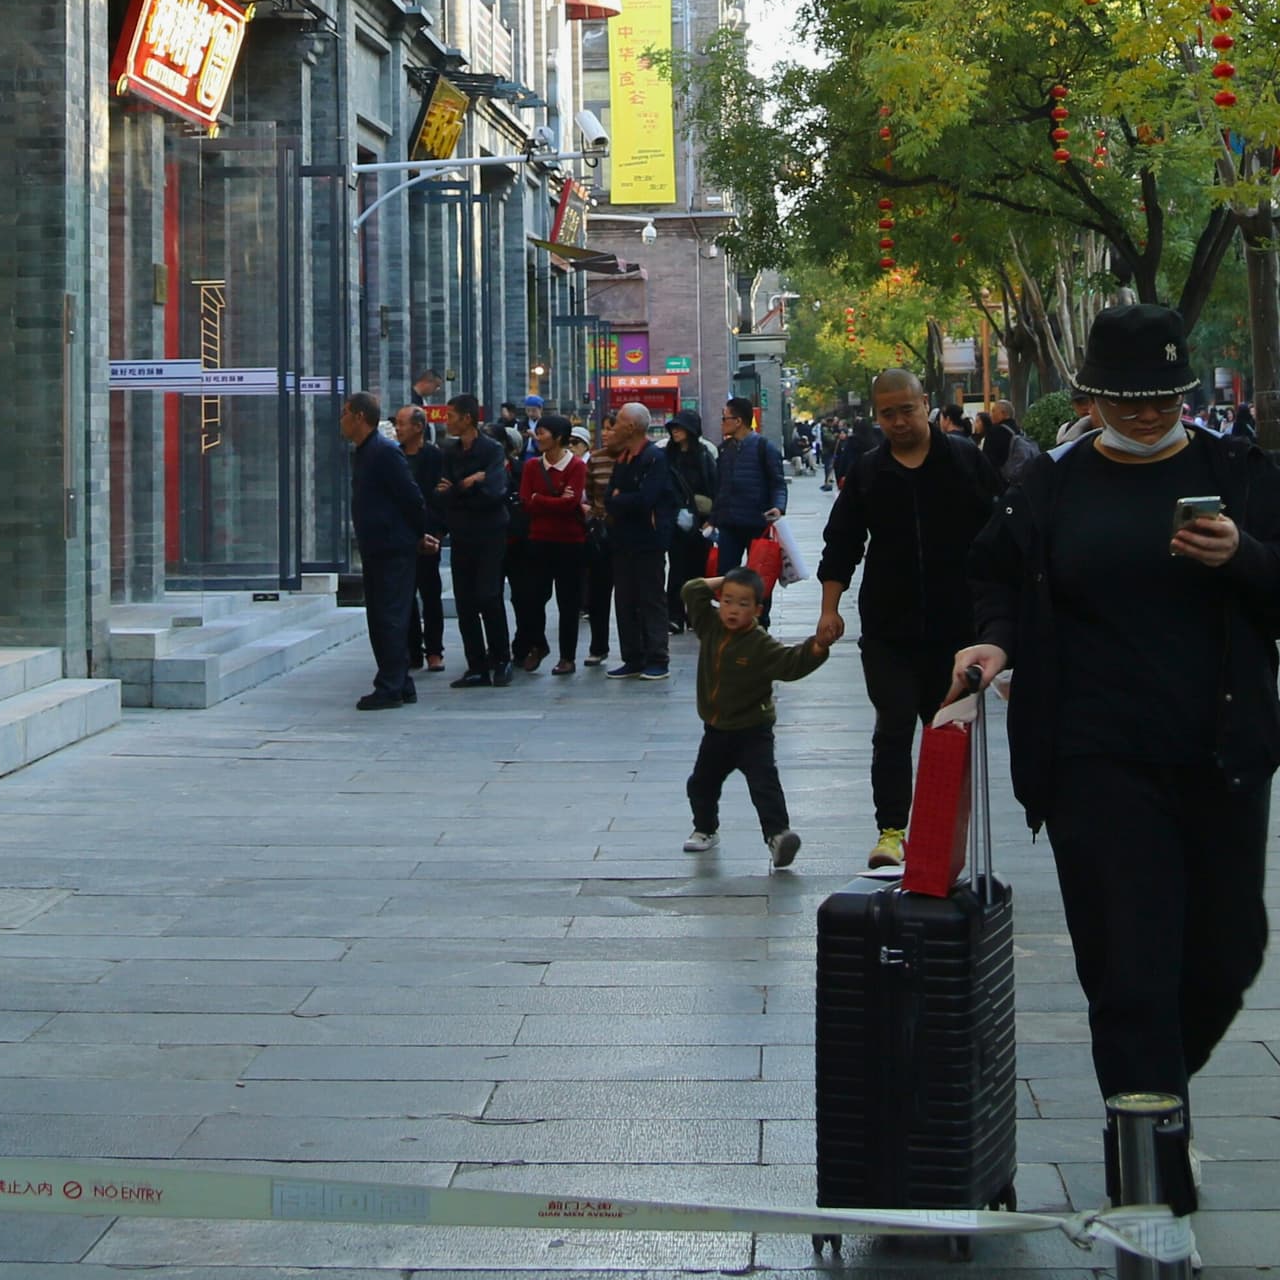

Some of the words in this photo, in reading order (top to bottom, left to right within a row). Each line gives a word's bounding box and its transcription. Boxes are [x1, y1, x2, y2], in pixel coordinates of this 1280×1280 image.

[94, 1185, 118, 1199] NO
[121, 1186, 164, 1201] ENTRY
[548, 1200, 611, 1210] 前门大街
[538, 1210, 561, 1218] QIAN
